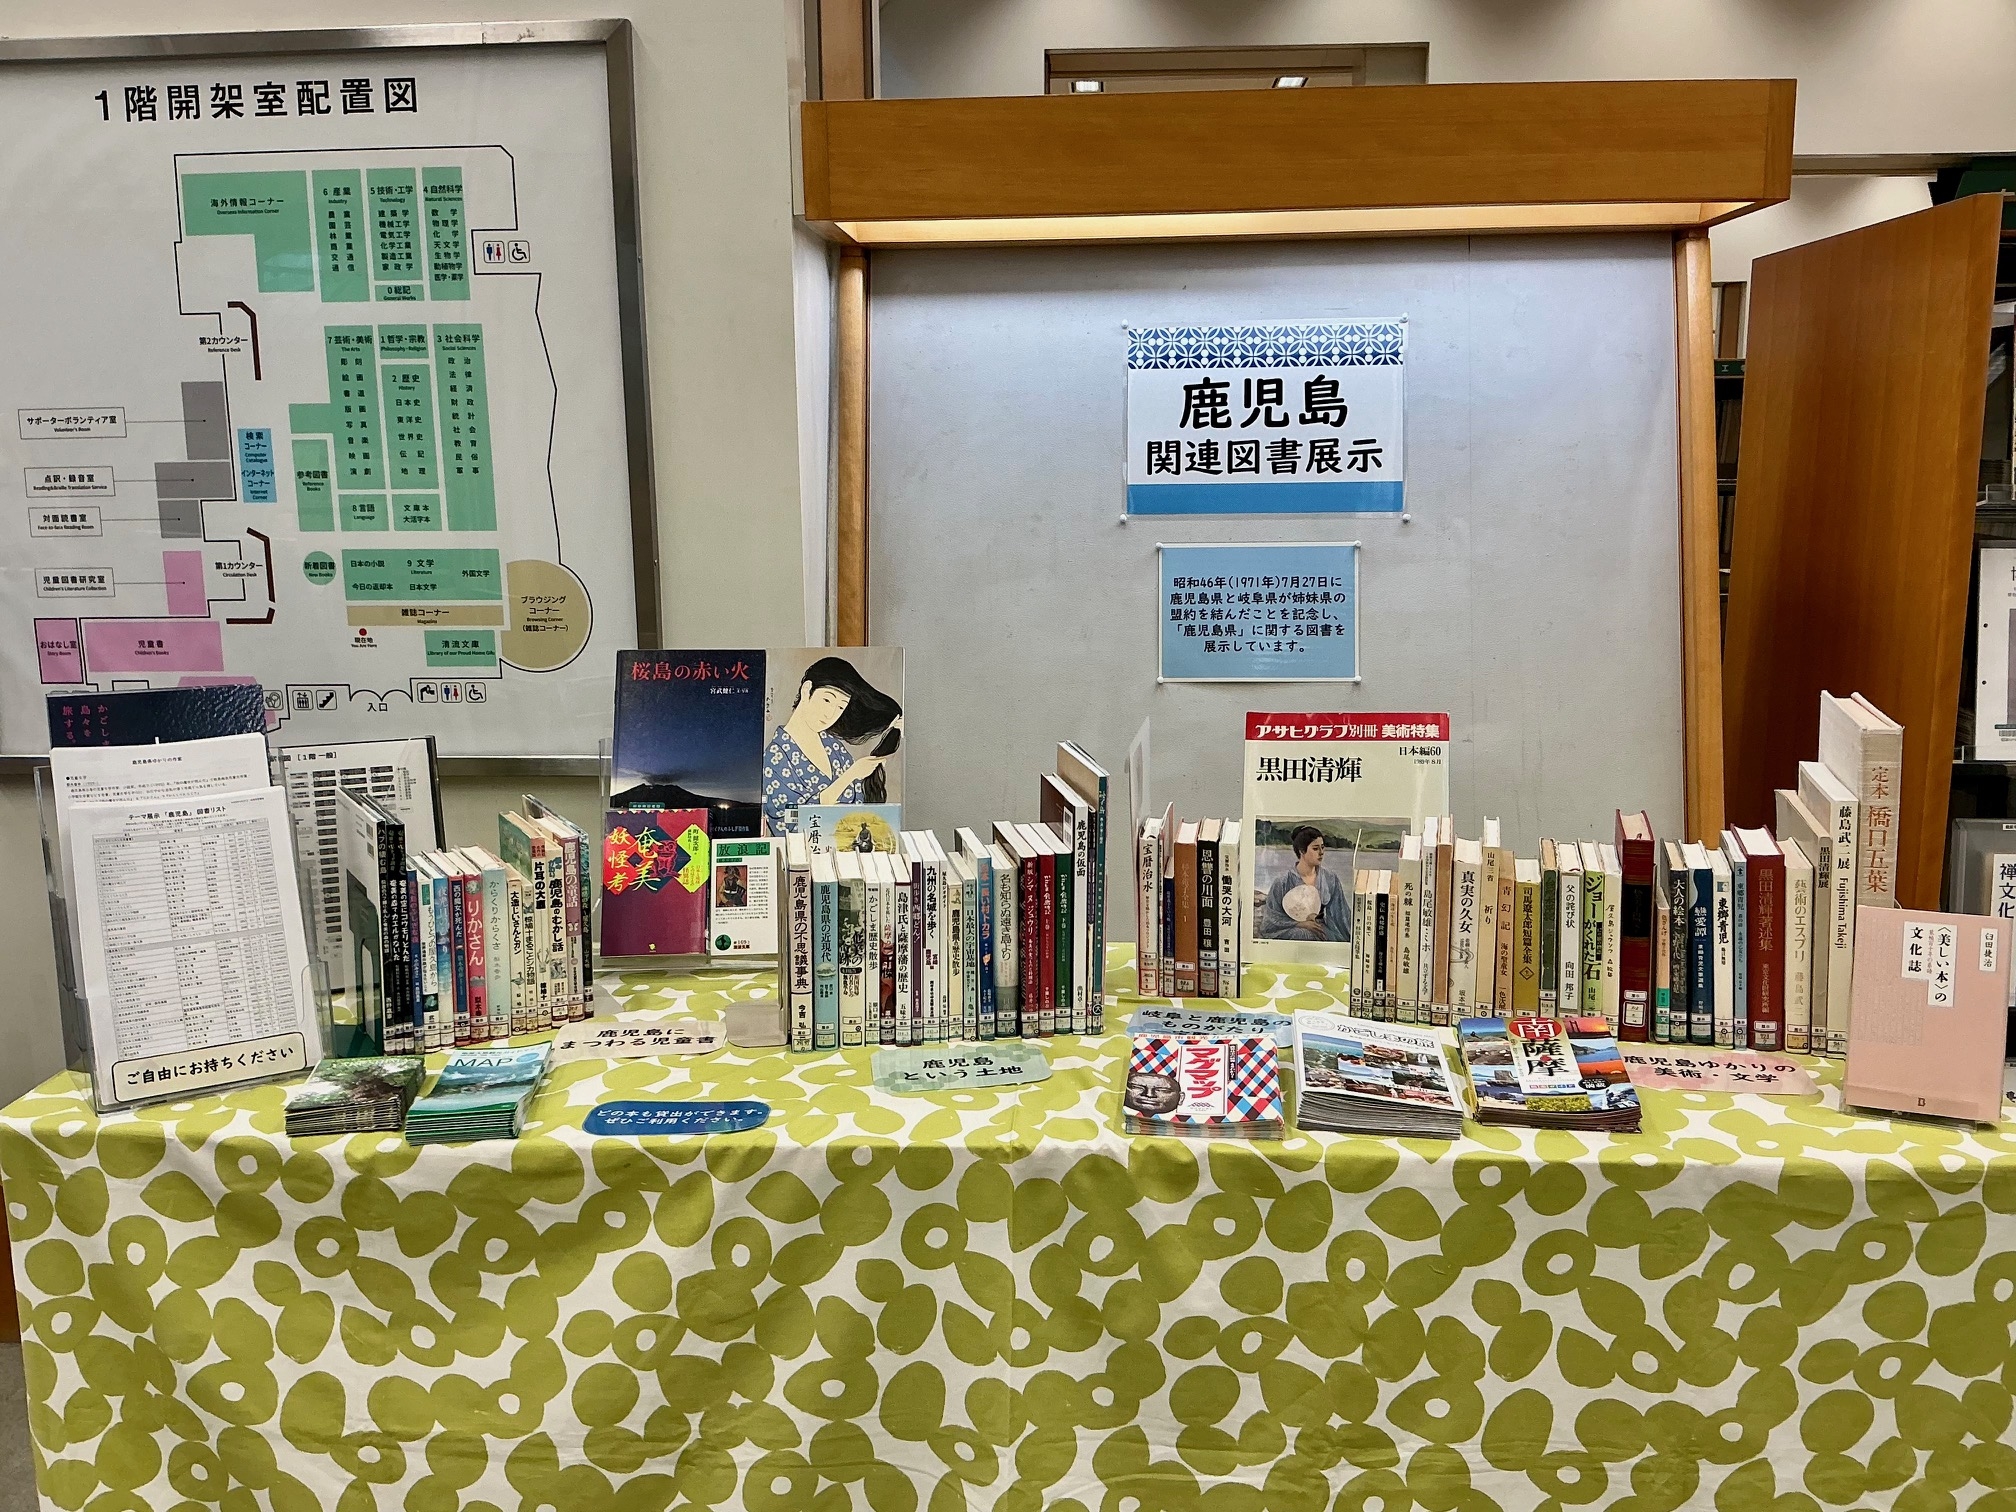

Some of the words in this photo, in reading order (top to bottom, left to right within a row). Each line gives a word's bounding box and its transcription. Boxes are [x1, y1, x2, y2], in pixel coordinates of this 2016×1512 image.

[95, 77, 418, 122] 1階開架室配置図
[332, 187, 351, 196] 産業
[377, 185, 413, 195] 技術・工学
[430, 185, 462, 194] 自然科学
[211, 198, 284, 207] 海外情報コーナー
[432, 219, 458, 227] 物理学
[433, 230, 459, 239] 化学
[433, 241, 460, 249] 天文学
[434, 251, 461, 260] 生物学
[199, 336, 248, 345] 第2カウンター
[334, 335, 372, 345] 芸術・美術
[387, 335, 426, 344] 哲学・宗教
[445, 335, 480, 343] 社会科学
[402, 374, 420, 383] 歴史
[1179, 374, 1348, 430] 鹿児島
[27, 415, 117, 425] サポーターボランティア室
[453, 426, 476, 434] 社会
[1146, 438, 1383, 476] 関連図書展示
[297, 471, 328, 479] 参考図書
[359, 504, 375, 513] 言語
[215, 562, 263, 570] 第1カウンター
[304, 562, 335, 570] 新着図書
[351, 560, 385, 568] 日本の小説
[417, 559, 434, 568] 文学
[462, 570, 490, 578] 外国文学
[1173, 576, 1342, 588] 昭和46年(1971年)7月27日に
[352, 583, 393, 591] 今日の返却本
[409, 583, 437, 591] 日本文学
[521, 596, 566, 604] ブラウジング
[1170, 592, 1346, 605] 鹿児島県と岐阜県が姉妹県の
[401, 608, 449, 617] 雑誌コーナー
[1170, 608, 1340, 621] 盟約を結んだことを記念し、
[1176, 624, 1345, 637] 「鹿児島県」に関する図書を
[40, 640, 77, 649] おはなし室
[441, 640, 480, 648] 清流文庫
[1203, 640, 1306, 653] 展示しています。
[632, 661, 750, 681] 桜島の赤い火
[367, 703, 388, 712] 入口
[81, 705, 91, 737] 島々を
[1255, 723, 1377, 739] アサヒグラフ別冊
[1382, 724, 1439, 738] 美術特集
[1399, 746, 1441, 756] 日本編60
[1255, 756, 1362, 783] 黒田清輝
[1871, 767, 1889, 799] 定本
[1837, 806, 1852, 870] 藤島武二展
[718, 844, 770, 856] 放浪記
[1076, 820, 1087, 876] 鹿児島の仮面
[1865, 805, 1892, 893] 橋口五葉
[607, 828, 631, 892] 妖怪考
[628, 826, 662, 891] 奄美
[1486, 852, 1495, 882] 山尾三省
[1818, 846, 1830, 888] 黒田清輝展
[1142, 844, 1153, 892] 宝暦治水
[1201, 849, 1214, 908] 恩讐の川面
[926, 866, 937, 938] 九州の名城を歩く
[1221, 874, 1232, 927] 慟哭の大河
[1459, 870, 1475, 934] 真実の久女
[1565, 884, 1575, 928] 父の詫び状
[1673, 880, 1685, 926] 大人の絵本
[1837, 878, 1849, 921] Fujishima
[489, 881, 501, 950] からくりからくさ
[549, 879, 564, 953] 鹿児島のむかし話
[1000, 873, 1012, 961] 名も知らぬ遠き島より
[1484, 905, 1493, 924] 祈り
[1500, 886, 1512, 931] 青幻記
[1758, 869, 1773, 952] 黒田清輝著述集
[820, 885, 831, 962] 鹿児島県の近現代
[1422, 889, 1433, 952] 島尾敏雄・ミホ
[1522, 887, 1533, 964] 司馬遼太郎短篇全集
[1584, 875, 1603, 980] ジョーがくれた石
[1717, 897, 1729, 944] 東郷青児
[1794, 879, 1807, 963] 藝術のエスプリ
[467, 900, 484, 966] りかさん
[793, 876, 809, 989] 鹿児島県の不思議事典
[868, 895, 878, 970] かごしま歴史散歩
[965, 909, 975, 967] 日本最大の宇宙基地
[1835, 923, 1847, 949] Takeji
[897, 892, 909, 993] 島津氏と薩摩藩の歴史
[951, 909, 961, 976] 鹿児島県の歴史散歩
[1908, 927, 1924, 973] 文化誌
[1402, 946, 1410, 974] 島尾敏雄
[1935, 927, 1952, 1002] 〈美しい本〉の
[1565, 961, 1575, 1000] 向田邦子
[1142, 1010, 1292, 1026] 岐阜と鹿児島の
[597, 1028, 685, 1038] 鹿児島に
[1162, 1020, 1264, 1034] ものがたり
[560, 1036, 717, 1049] まつわる児童書
[1514, 1018, 1569, 1077] 南薩摩
[127, 1047, 294, 1085] ご自由にお持ちください
[454, 1058, 513, 1067] MAP
[922, 1056, 994, 1069] 鹿児島
[1624, 1056, 1796, 1073] 鹿児島ゆかりの
[904, 1066, 1024, 1081] という土地
[1654, 1067, 1780, 1083] 美術・文学
[597, 1108, 763, 1117] どの本も貸出ができます。
[604, 1117, 743, 1125] ぜひご利用ください。
